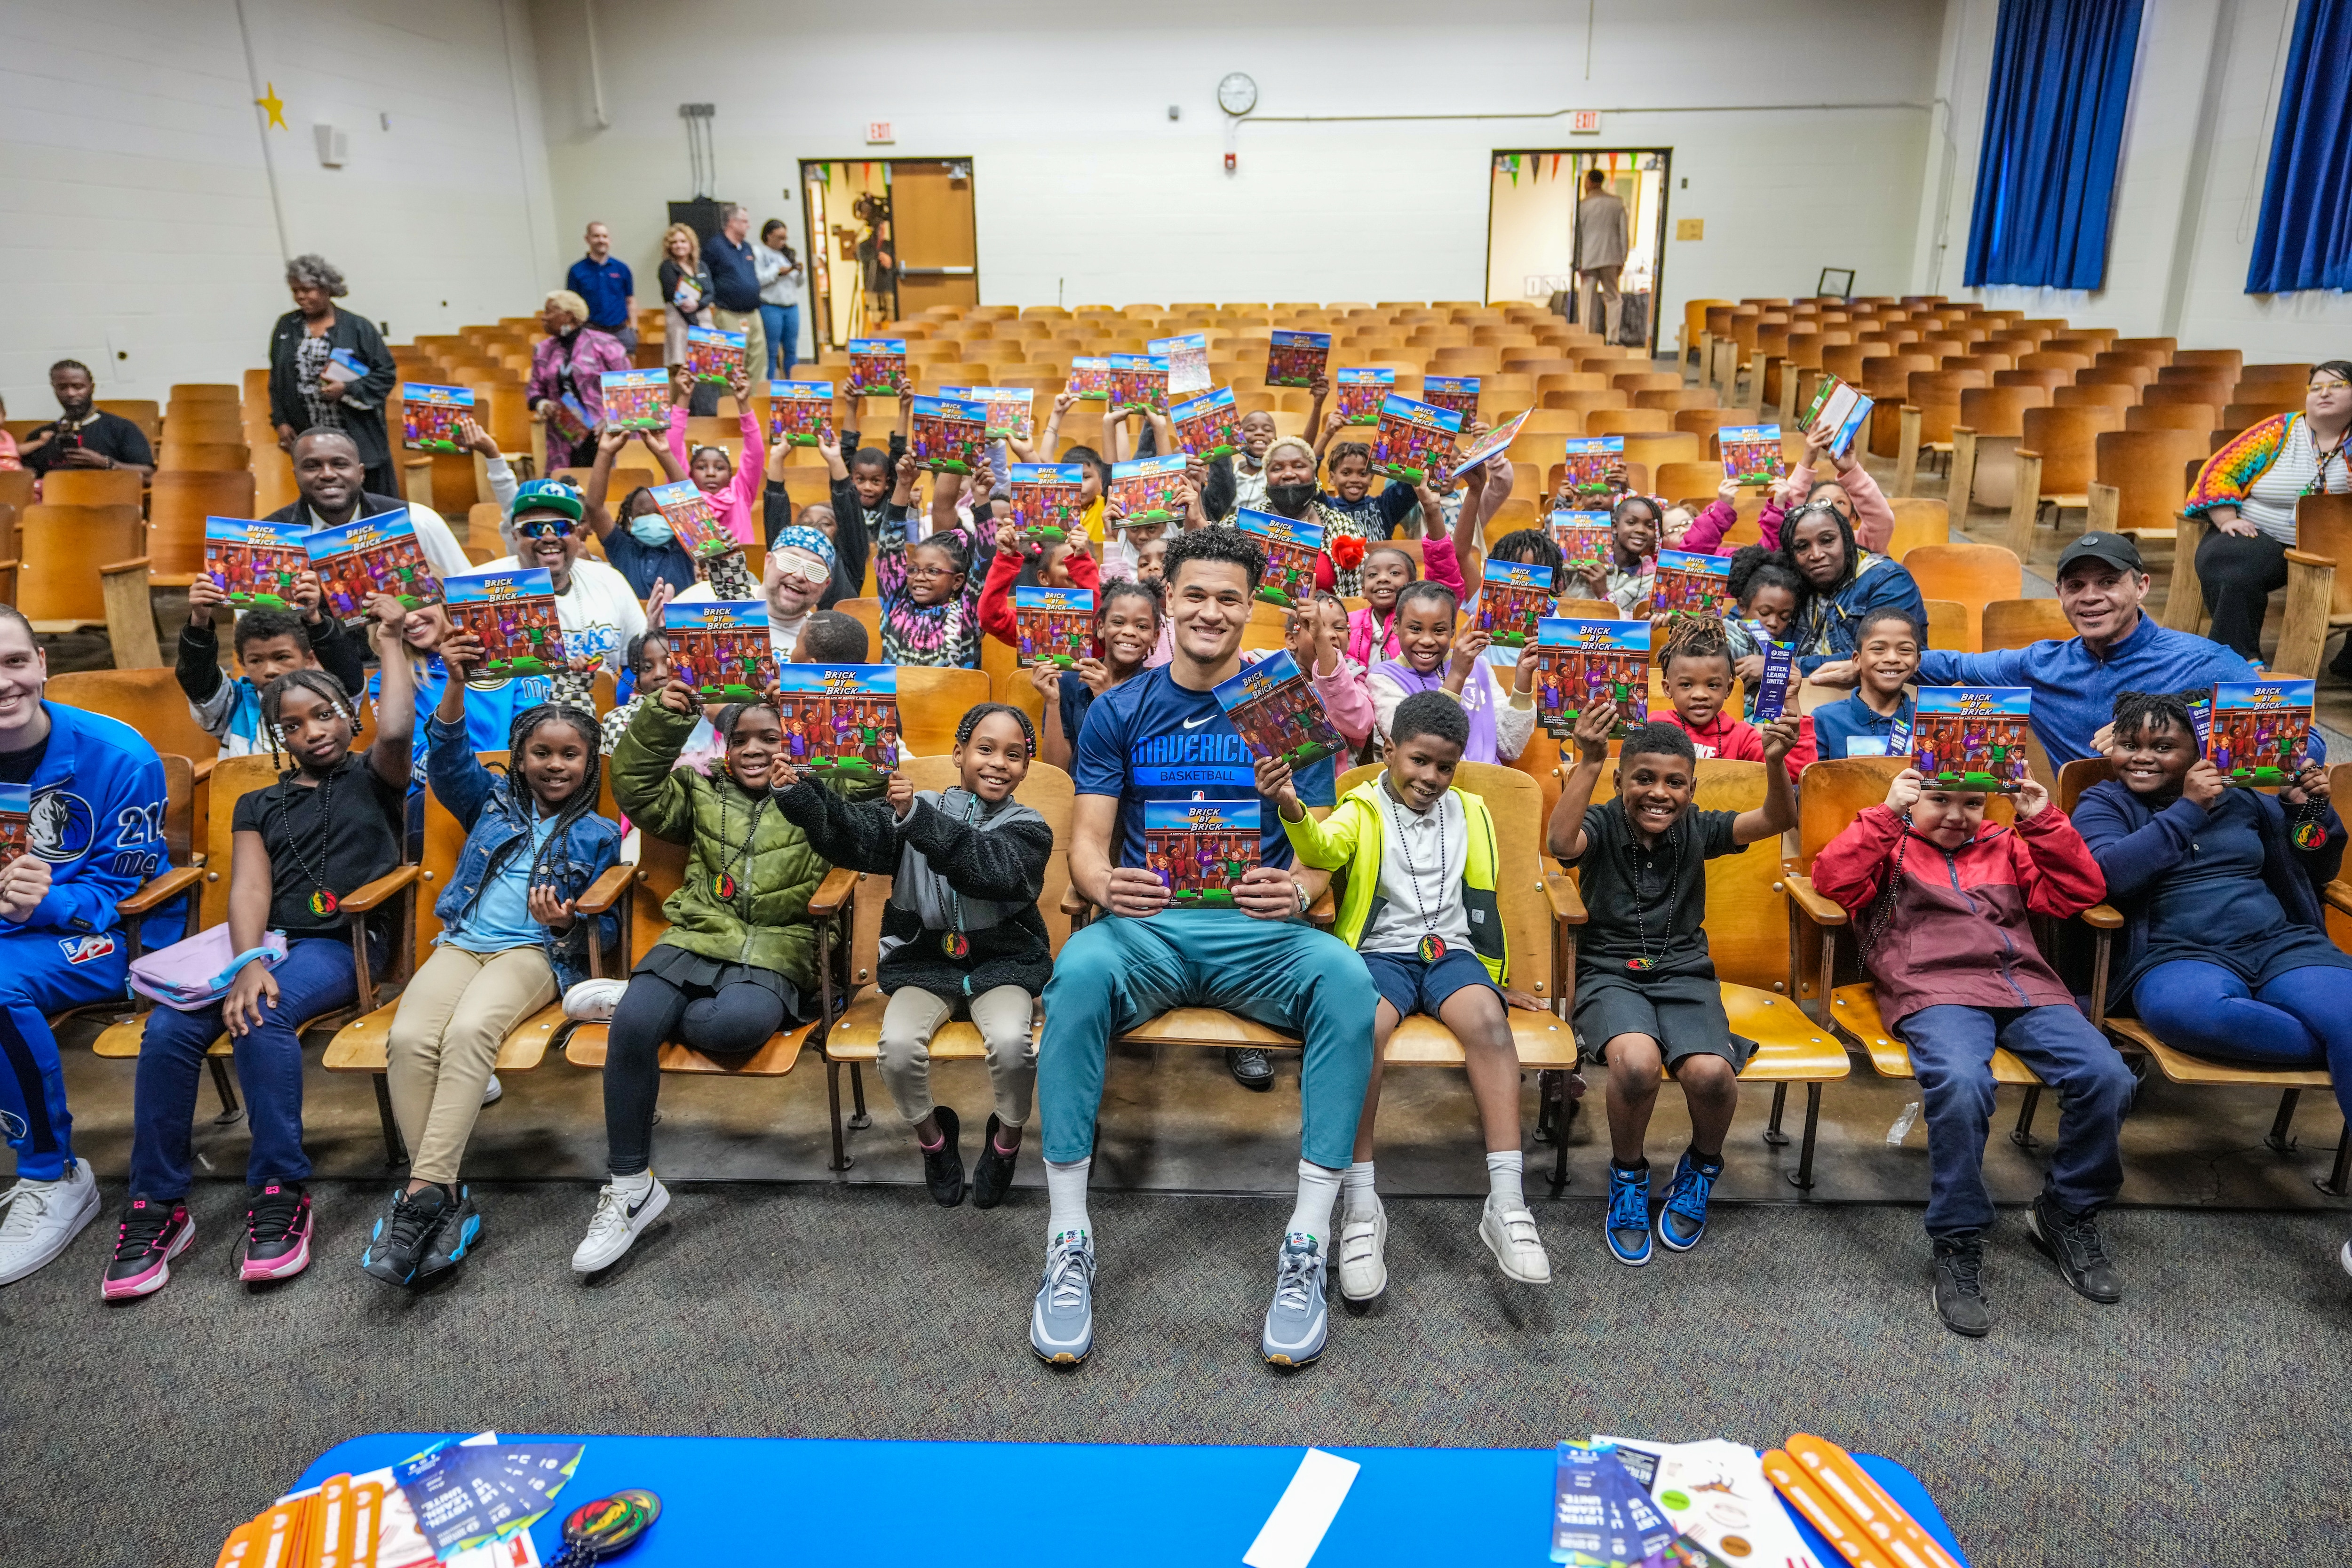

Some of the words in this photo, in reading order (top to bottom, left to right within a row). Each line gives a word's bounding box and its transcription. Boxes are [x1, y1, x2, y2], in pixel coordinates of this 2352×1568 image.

[1576, 112, 1596, 128] EXIT
[871, 123, 890, 139] EXIT
[1193, 398, 1210, 408] BRICK
[1197, 406, 1213, 416] BRICK
[1414, 405, 1436, 415] BRICK
[1411, 417, 1434, 427] BRICK
[247, 525, 276, 533] BRICK
[1269, 520, 1293, 531] BRICK
[346, 524, 375, 539] BRICK
[358, 534, 368, 542] BY
[1267, 532, 1292, 542] BRICK
[353, 537, 381, 552] BRICK
[484, 578, 513, 588] BRICK
[489, 593, 517, 602] BRICK
[703, 608, 731, 616] BRICK
[1580, 626, 1611, 635] BRICK
[1581, 641, 1612, 650] BRICK
[824, 670, 856, 679] BRICK
[1242, 670, 1263, 687] BRICK
[826, 686, 858, 695] BRICK
[1253, 681, 1261, 690] BY
[1251, 683, 1273, 699] BRICK
[2253, 687, 2282, 696] BRICK
[2253, 702, 2282, 710] BRICK
[1891, 737, 1905, 747] LEARN.
[1892, 733, 1906, 743] LISTEN.
[1891, 741, 1903, 751] UNITE.
[1160, 770, 1235, 781] BASKETBALL
[1188, 808, 1220, 816] BRICK
[63, 941, 77, 956] NBA
[265, 1186, 279, 1194] 23
[134, 1200, 145, 1209] 23
[421, 1486, 462, 1510] UNITE.
[1561, 1494, 1602, 1505] UNITE.
[422, 1492, 469, 1520] LEARN.
[1559, 1503, 1603, 1515] LEARN.
[425, 1500, 473, 1528] LISTEN.
[1557, 1512, 1604, 1526] LISTEN.
